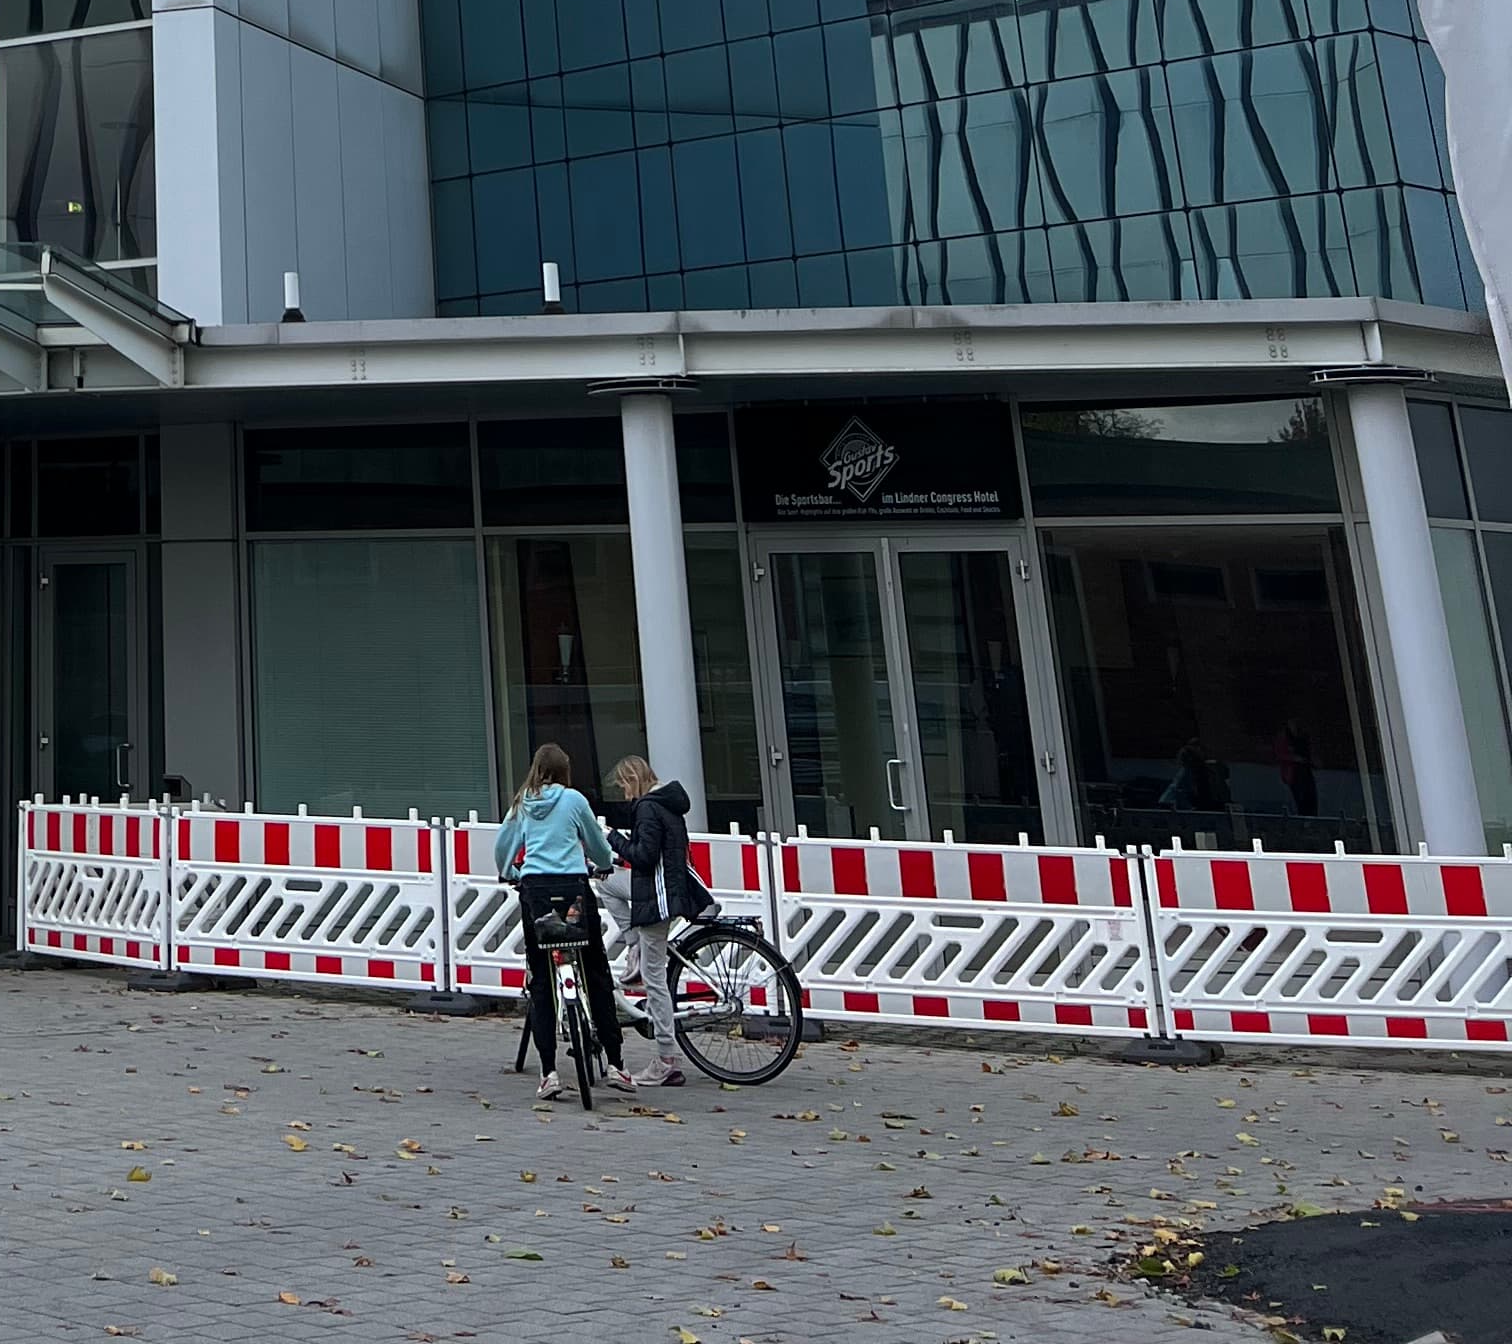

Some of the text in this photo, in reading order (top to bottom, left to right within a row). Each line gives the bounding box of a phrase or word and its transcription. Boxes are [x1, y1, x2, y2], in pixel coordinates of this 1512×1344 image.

[843, 445, 877, 464] Gustav
[827, 444, 895, 490] Sports
[775, 494, 789, 506] Die
[881, 492, 893, 504] im
[894, 491, 928, 504] Lindner
[930, 491, 972, 506] Congress
[973, 490, 1000, 503] Hotel
